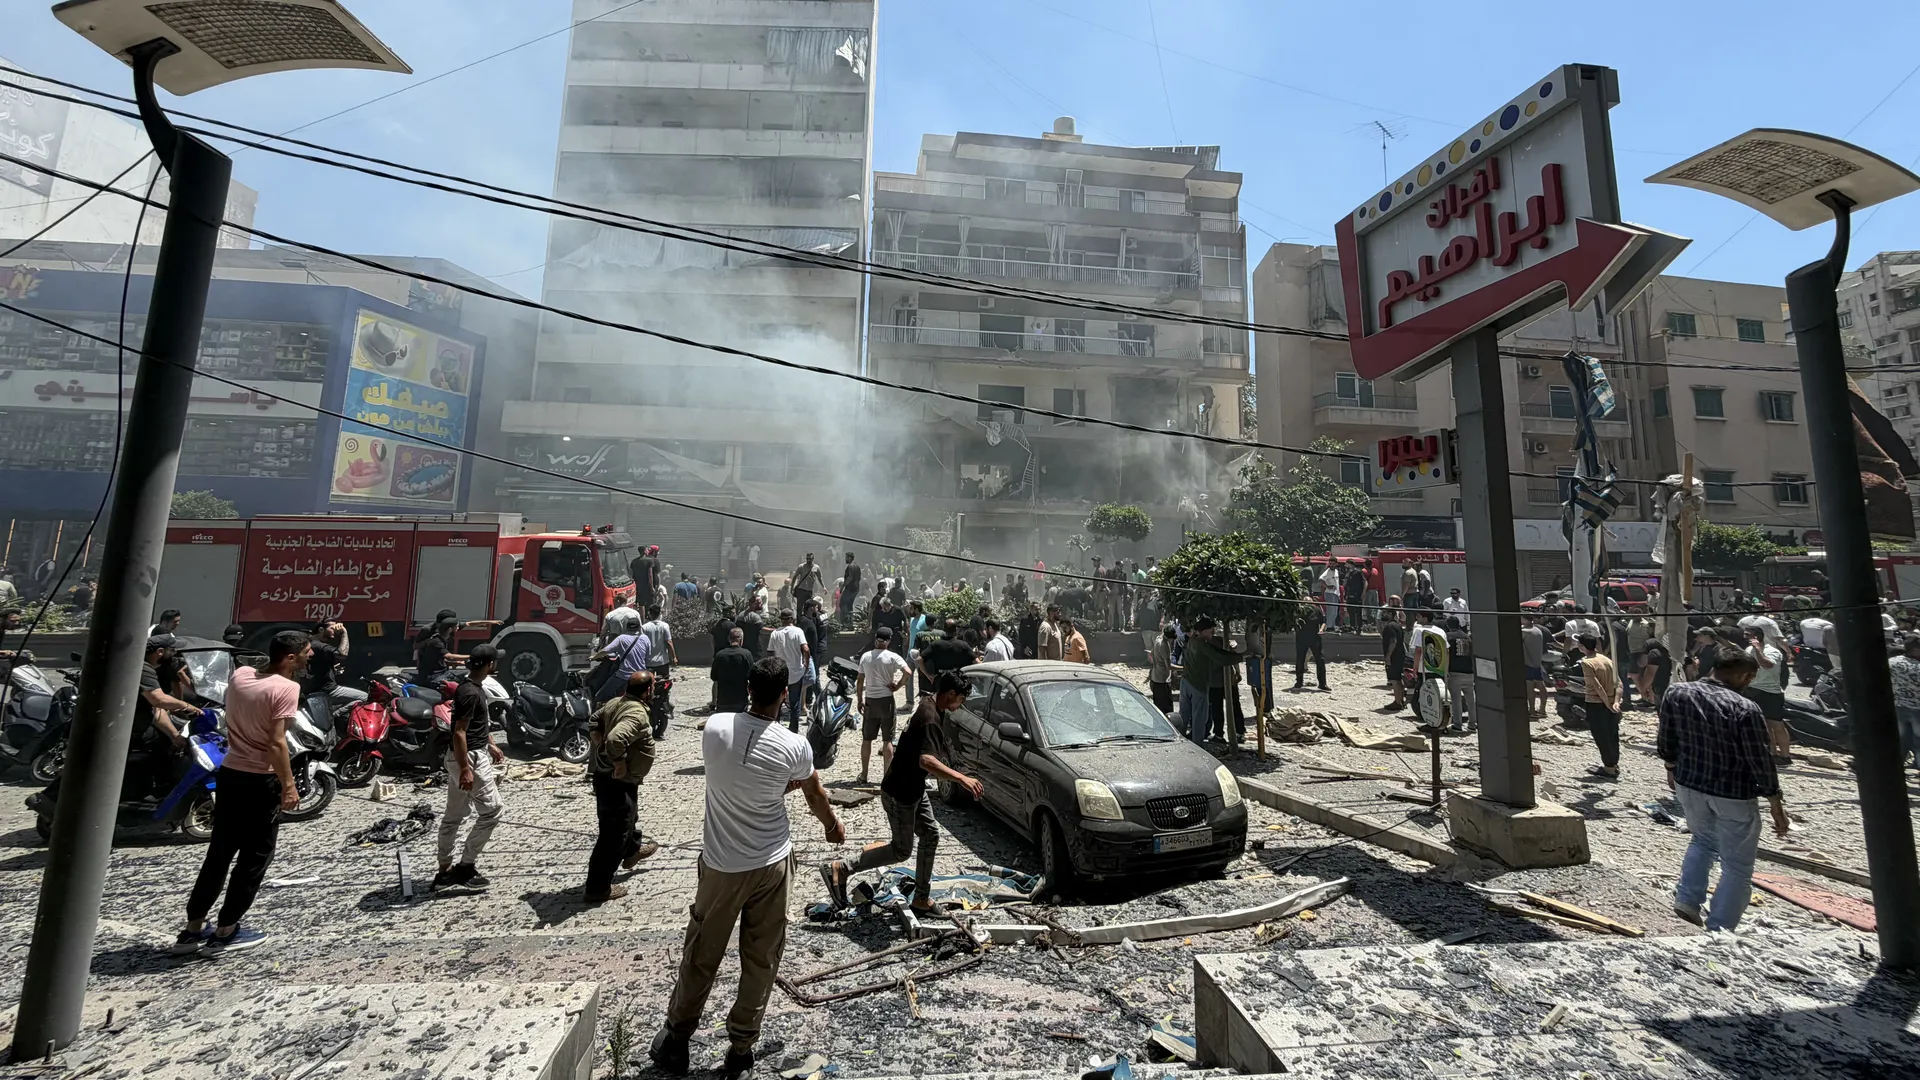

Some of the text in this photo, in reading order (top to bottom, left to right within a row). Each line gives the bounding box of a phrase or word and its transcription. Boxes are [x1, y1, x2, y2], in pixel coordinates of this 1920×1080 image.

[1426, 156, 1501, 228] افران
[1379, 163, 1565, 328] ابراهيم
[362, 382, 449, 419] صيفك
[356, 410, 390, 425] هون
[393, 418, 415, 431] من
[1378, 435, 1438, 477] بيتزا
[265, 535, 396, 551] إتحاد بلديات الضاحية الجنوبية
[261, 558, 393, 581] فوج إطفاء الضاحية
[339, 585, 390, 602] مركز
[303, 604, 334, 620] 1290
